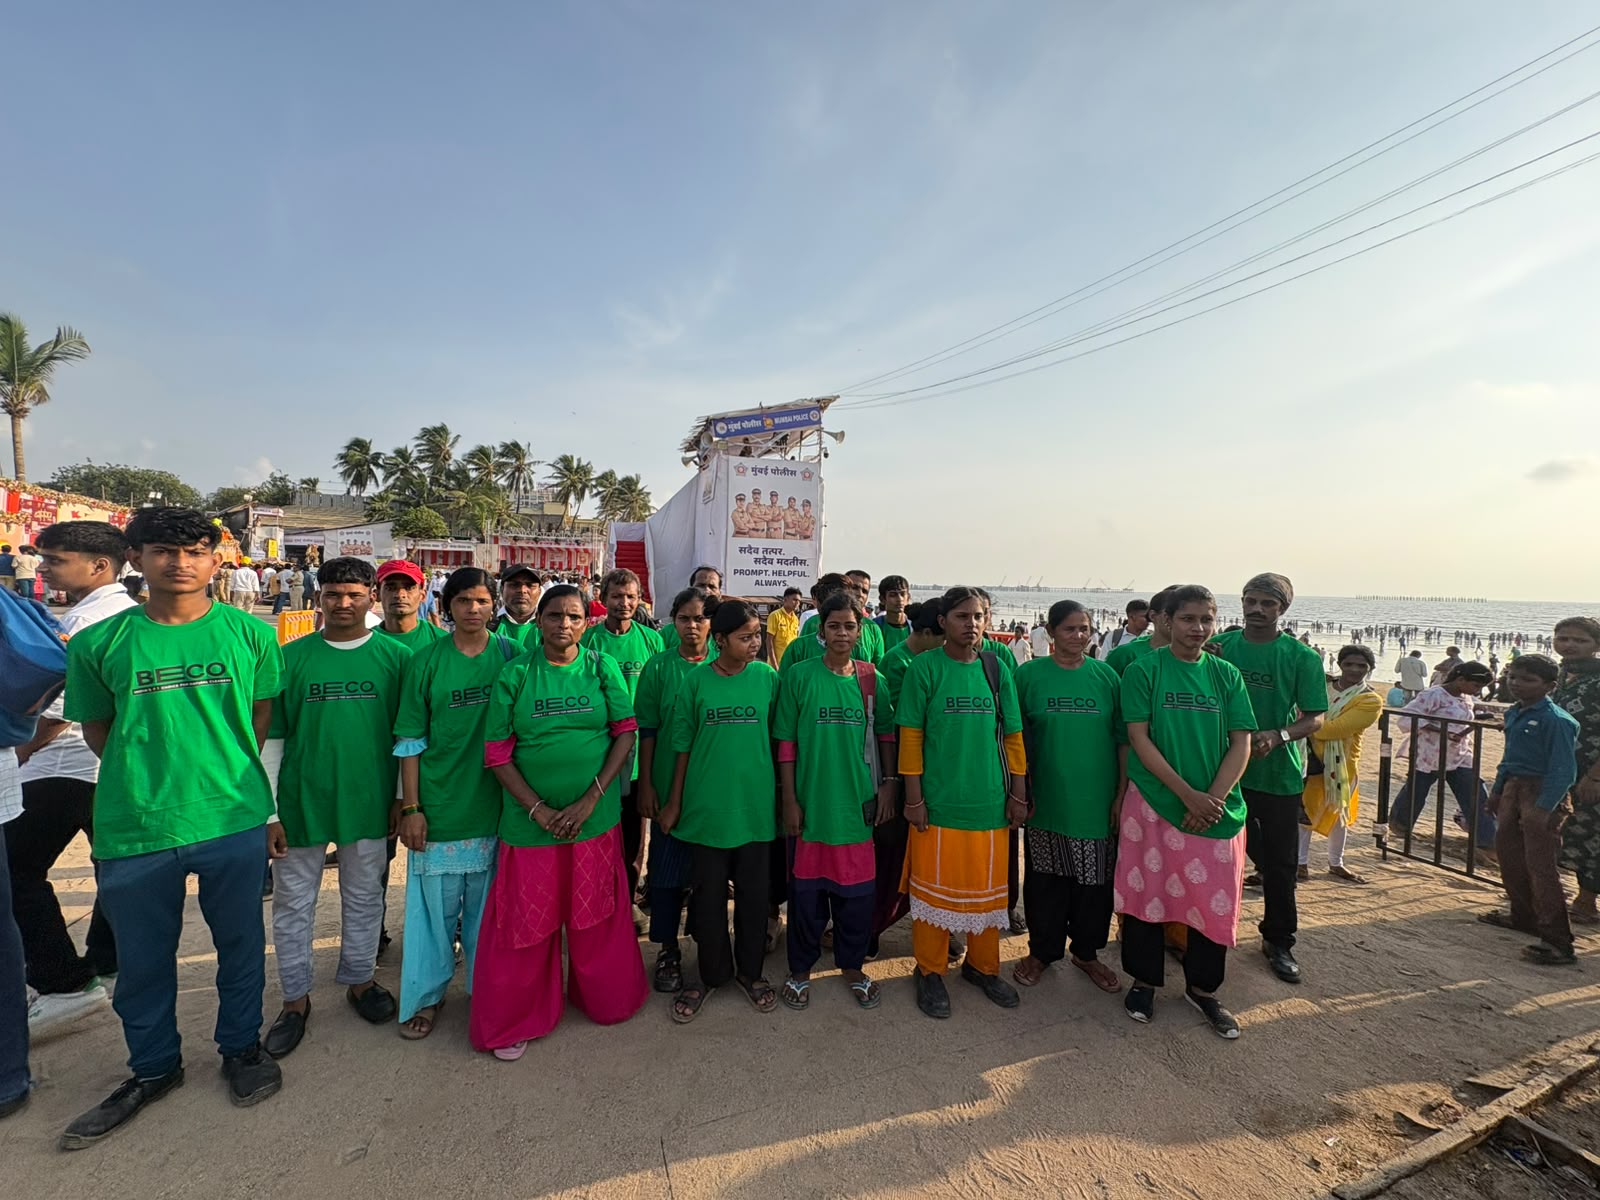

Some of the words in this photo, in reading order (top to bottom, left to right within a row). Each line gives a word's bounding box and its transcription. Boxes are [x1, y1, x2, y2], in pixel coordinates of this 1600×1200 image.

[793, 413, 809, 422] POLICE
[751, 464, 769, 476] मुंबई
[770, 466, 797, 477] पोलीस
[733, 568, 770, 577] PROMPT.
[771, 569, 810, 578] HELPFUL.
[754, 579, 789, 587] ALWAYS.
[136, 661, 226, 686] BECO
[310, 681, 374, 695] BECO
[535, 696, 590, 711] BECO
[946, 697, 992, 708] BECO
[1047, 697, 1096, 708] BECO
[1165, 692, 1218, 706] BECO
[706, 706, 756, 720] BECO
[819, 707, 863, 719] BECO
